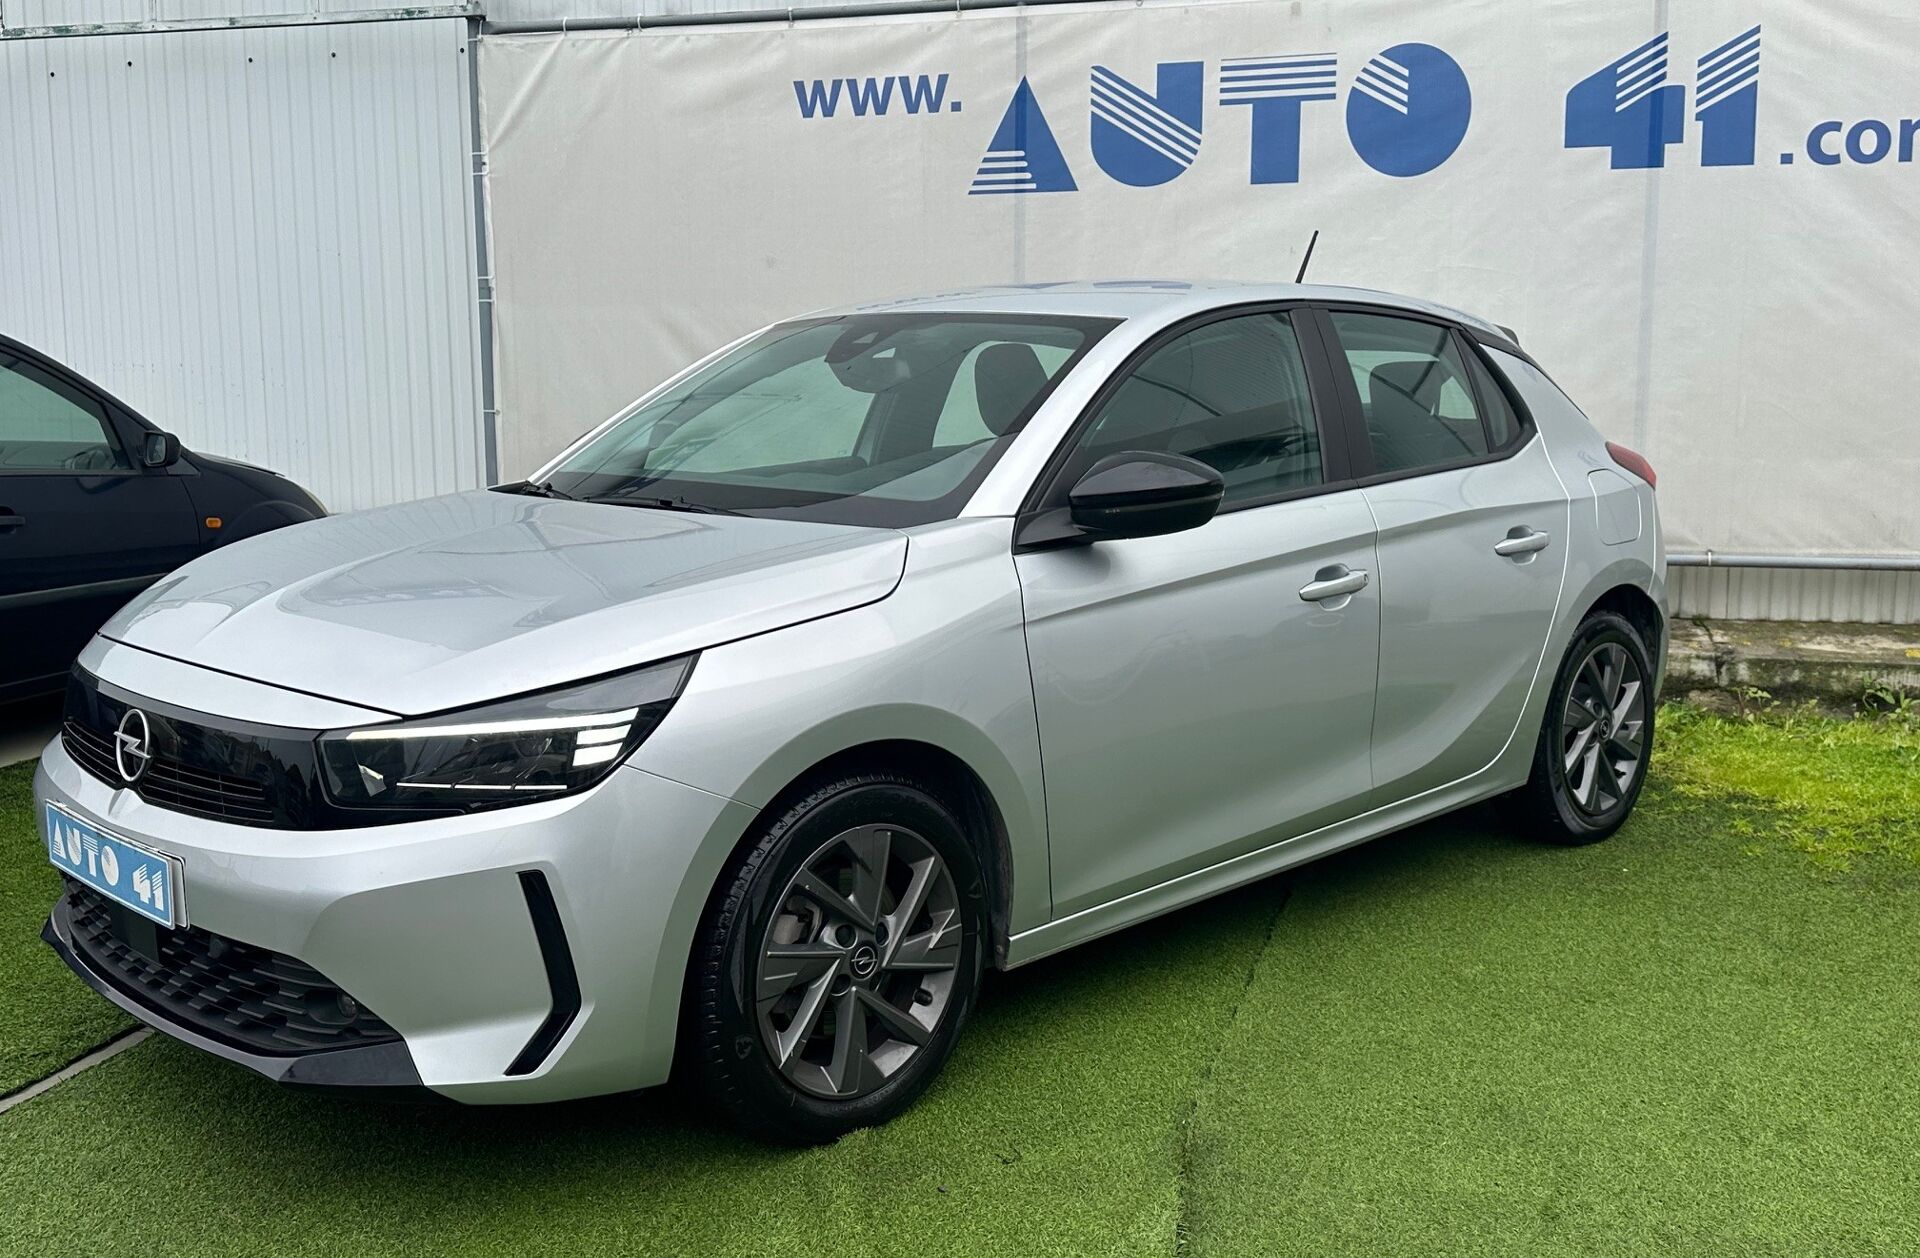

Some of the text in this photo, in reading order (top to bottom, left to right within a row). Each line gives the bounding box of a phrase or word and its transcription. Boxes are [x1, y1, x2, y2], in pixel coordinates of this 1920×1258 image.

[968, 42, 1472, 195] AUTO
[1564, 24, 1761, 169] 41
[52, 820, 165, 912] AUTO 41
